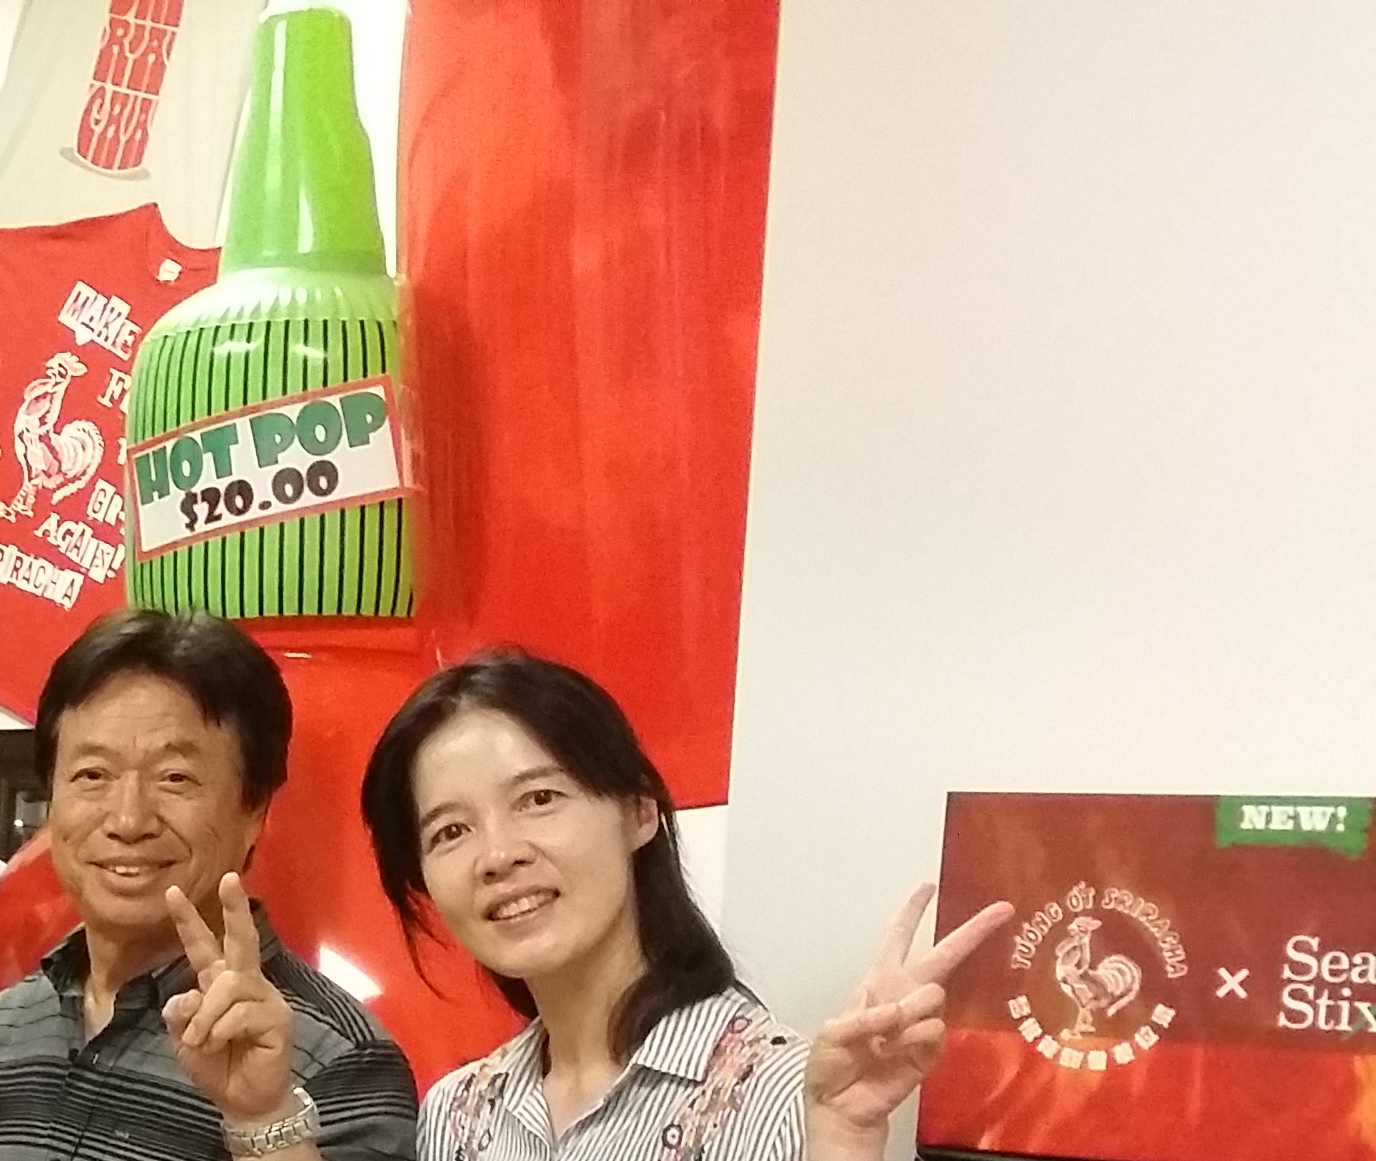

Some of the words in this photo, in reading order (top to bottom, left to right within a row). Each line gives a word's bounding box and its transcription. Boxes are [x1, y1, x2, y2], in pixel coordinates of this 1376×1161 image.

[63, 283, 142, 360] MAKE
[134, 423, 239, 506] HOT
[249, 392, 388, 468] POP
[180, 460, 339, 532] $20.00
[34, 512, 126, 583] AGAIN!
[1240, 804, 1347, 832] NEW!
